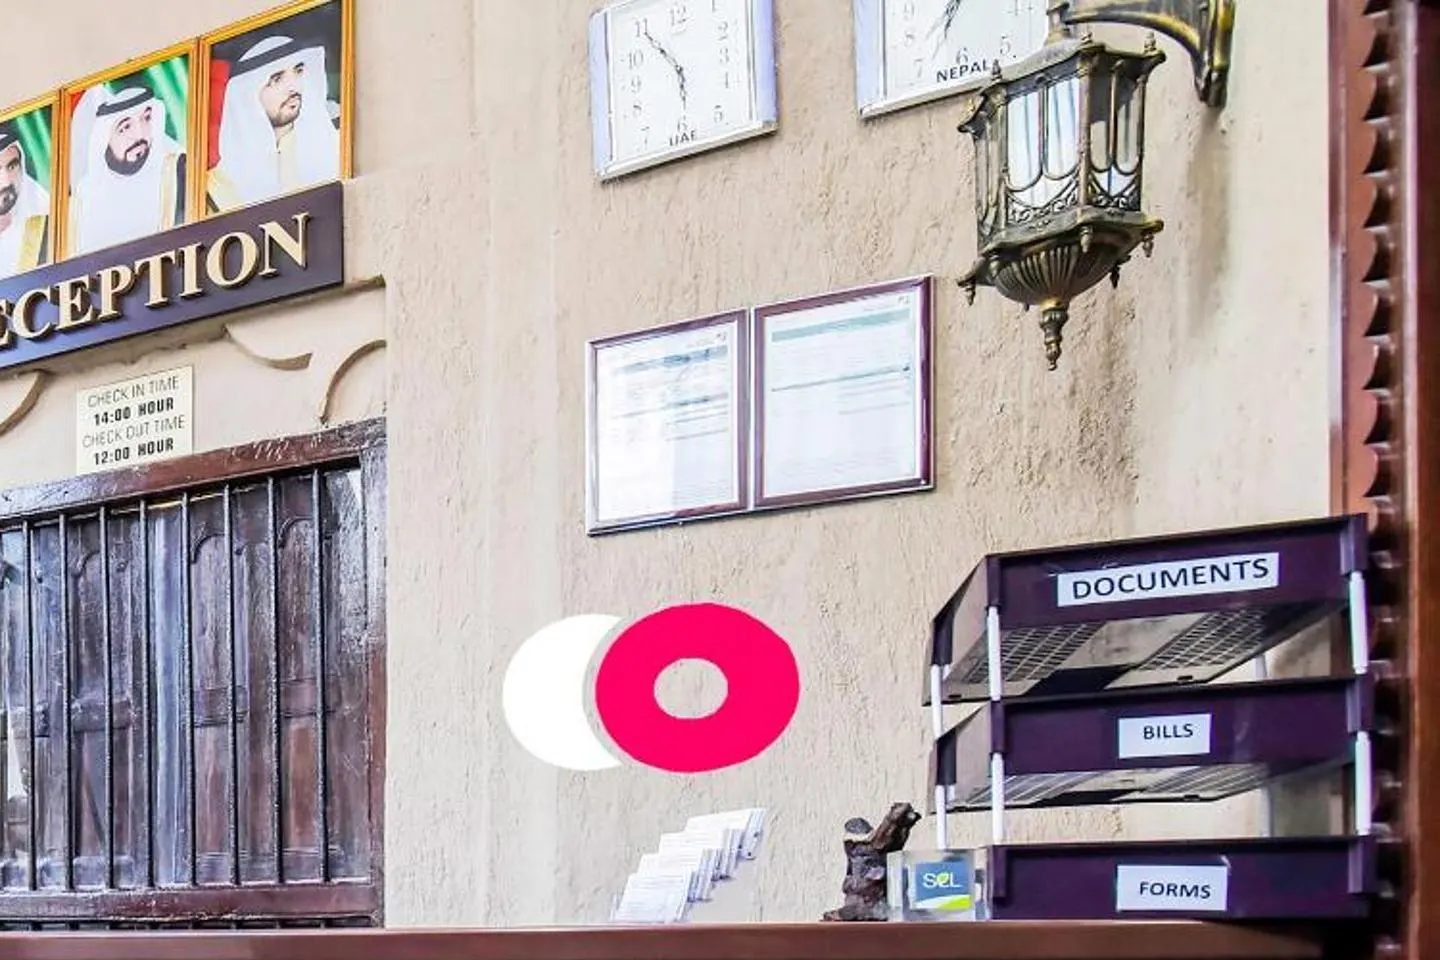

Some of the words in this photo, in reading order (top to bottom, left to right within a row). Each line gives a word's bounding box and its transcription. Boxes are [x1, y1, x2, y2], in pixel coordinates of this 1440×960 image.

[936, 59, 991, 83] NEPAL
[87, 387, 129, 408] CHECK
[131, 383, 145, 398] IN
[149, 375, 179, 394] TIME
[94, 406, 131, 426] 14:00
[138, 396, 174, 417] HOUR
[82, 429, 122, 448] CHECK
[126, 422, 150, 440] OUT
[154, 414, 185, 433] TIME
[94, 446, 130, 465] 12:00
[138, 437, 174, 456] HOUR
[1071, 557, 1270, 600] DOCUMENTS
[1142, 722, 1195, 741] BILLS
[1139, 880, 1212, 900] FORMS
